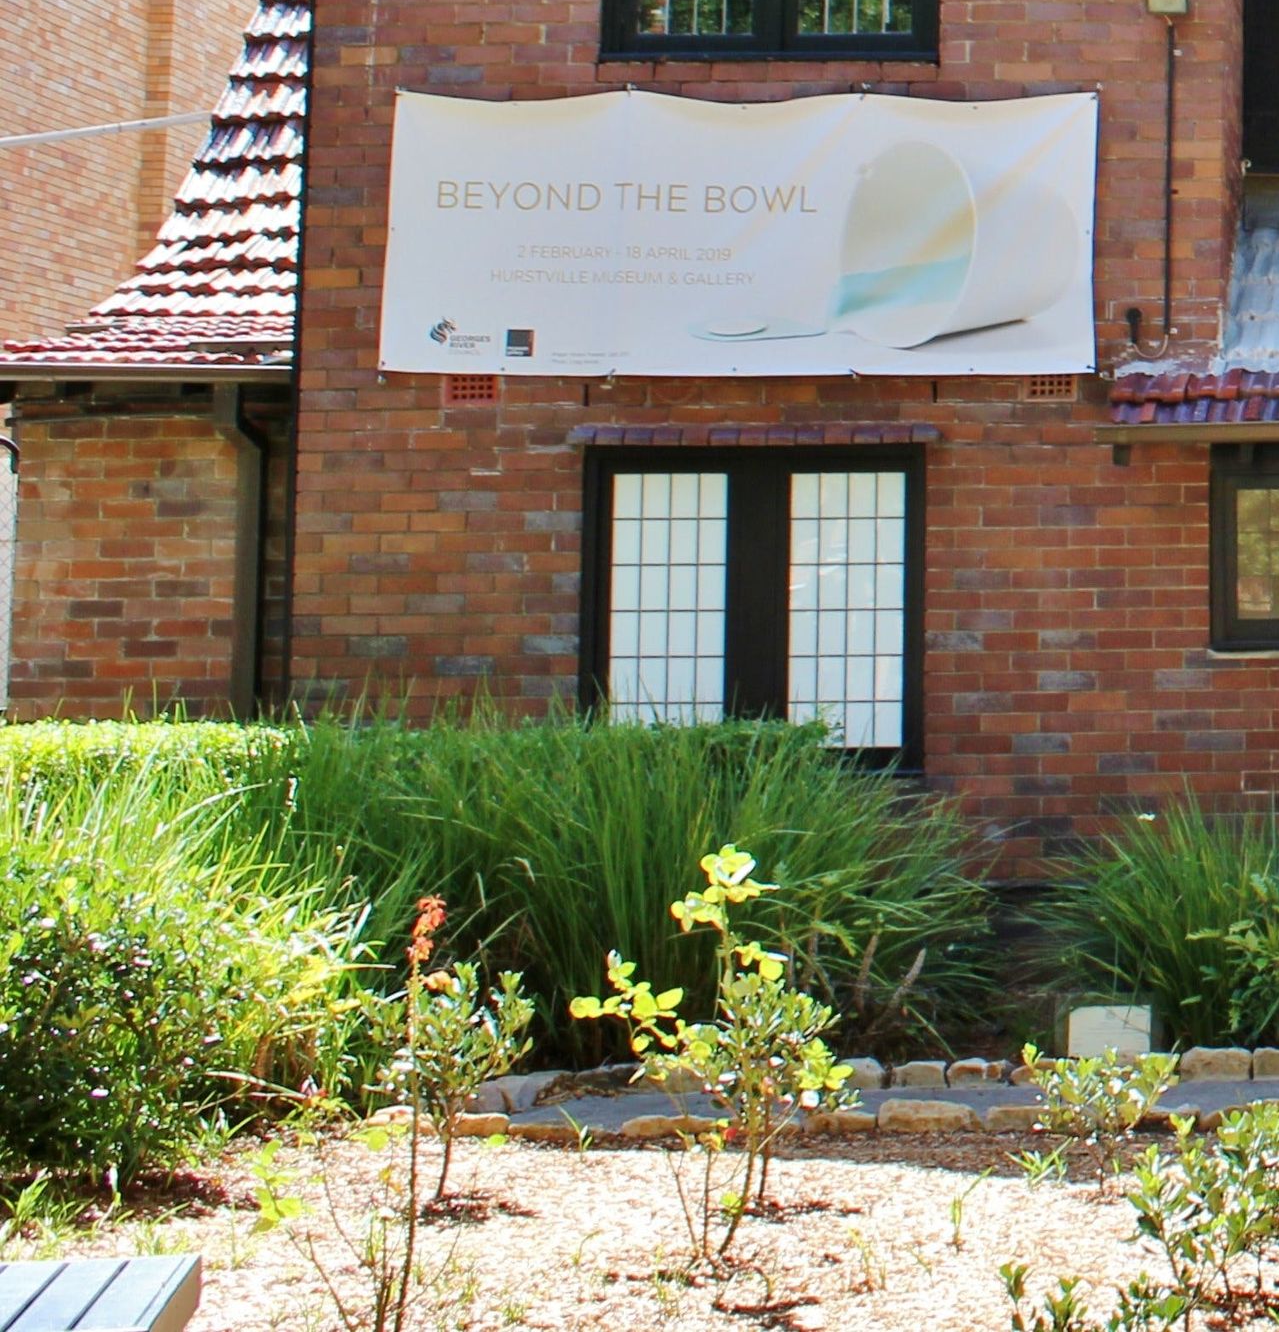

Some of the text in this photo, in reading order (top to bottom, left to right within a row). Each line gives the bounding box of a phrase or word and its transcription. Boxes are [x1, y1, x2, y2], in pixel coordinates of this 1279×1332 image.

[437, 180, 818, 213] BEYOND THE BOWL
[516, 245, 526, 259] 2
[530, 245, 612, 260] FEBRUARY
[626, 245, 641, 260] 18
[645, 246, 691, 261] APRIL
[696, 247, 732, 262] 2019
[490, 268, 755, 286] HURSTVILLE MUSEUM & GALLERY
